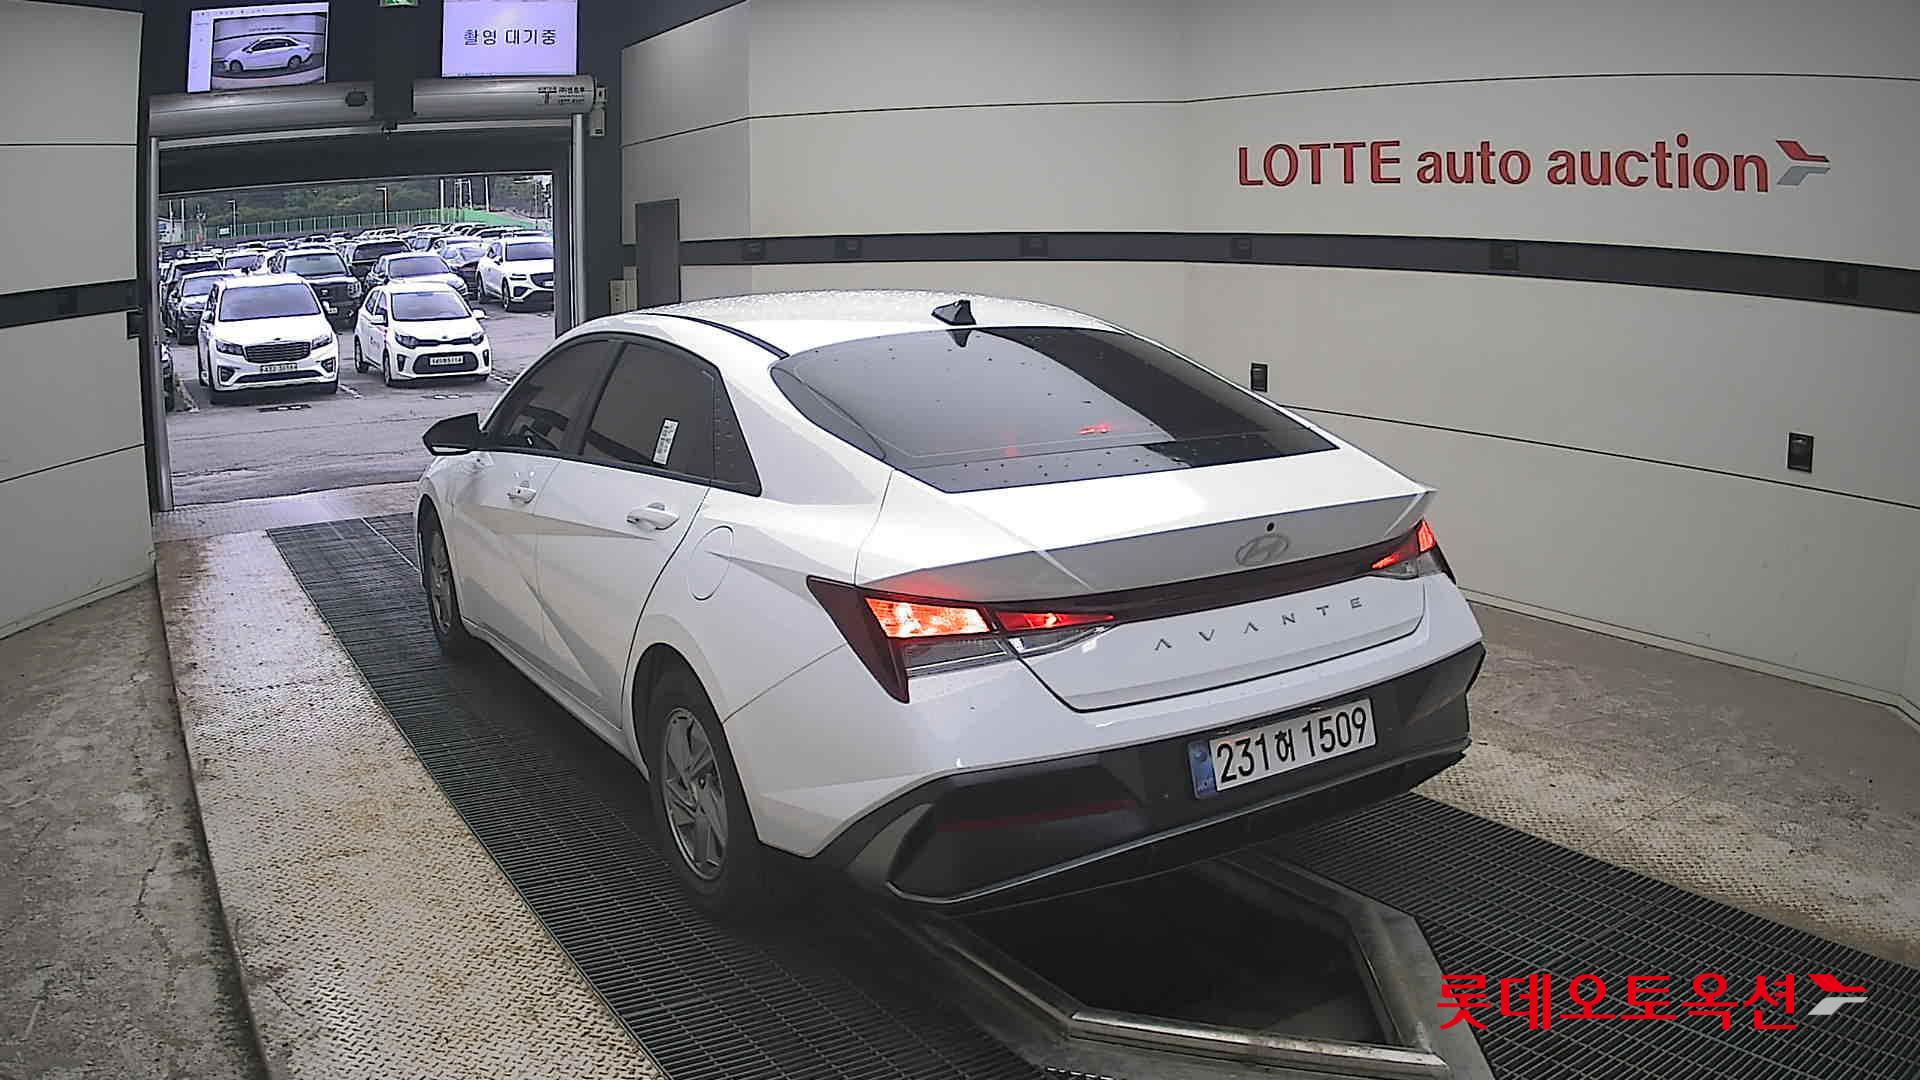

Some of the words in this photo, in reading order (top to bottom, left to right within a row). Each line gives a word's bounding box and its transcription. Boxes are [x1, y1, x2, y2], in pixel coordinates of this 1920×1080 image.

[464, 29, 497, 46] 촬영
[505, 29, 558, 46] 대기중
[1239, 140, 1400, 187] LOTTE
[1416, 141, 1531, 185] auto
[1547, 134, 1769, 192] auction
[1154, 597, 1362, 651] AVANTE
[1216, 728, 1296, 783] 231허
[1302, 706, 1367, 758] 1509
